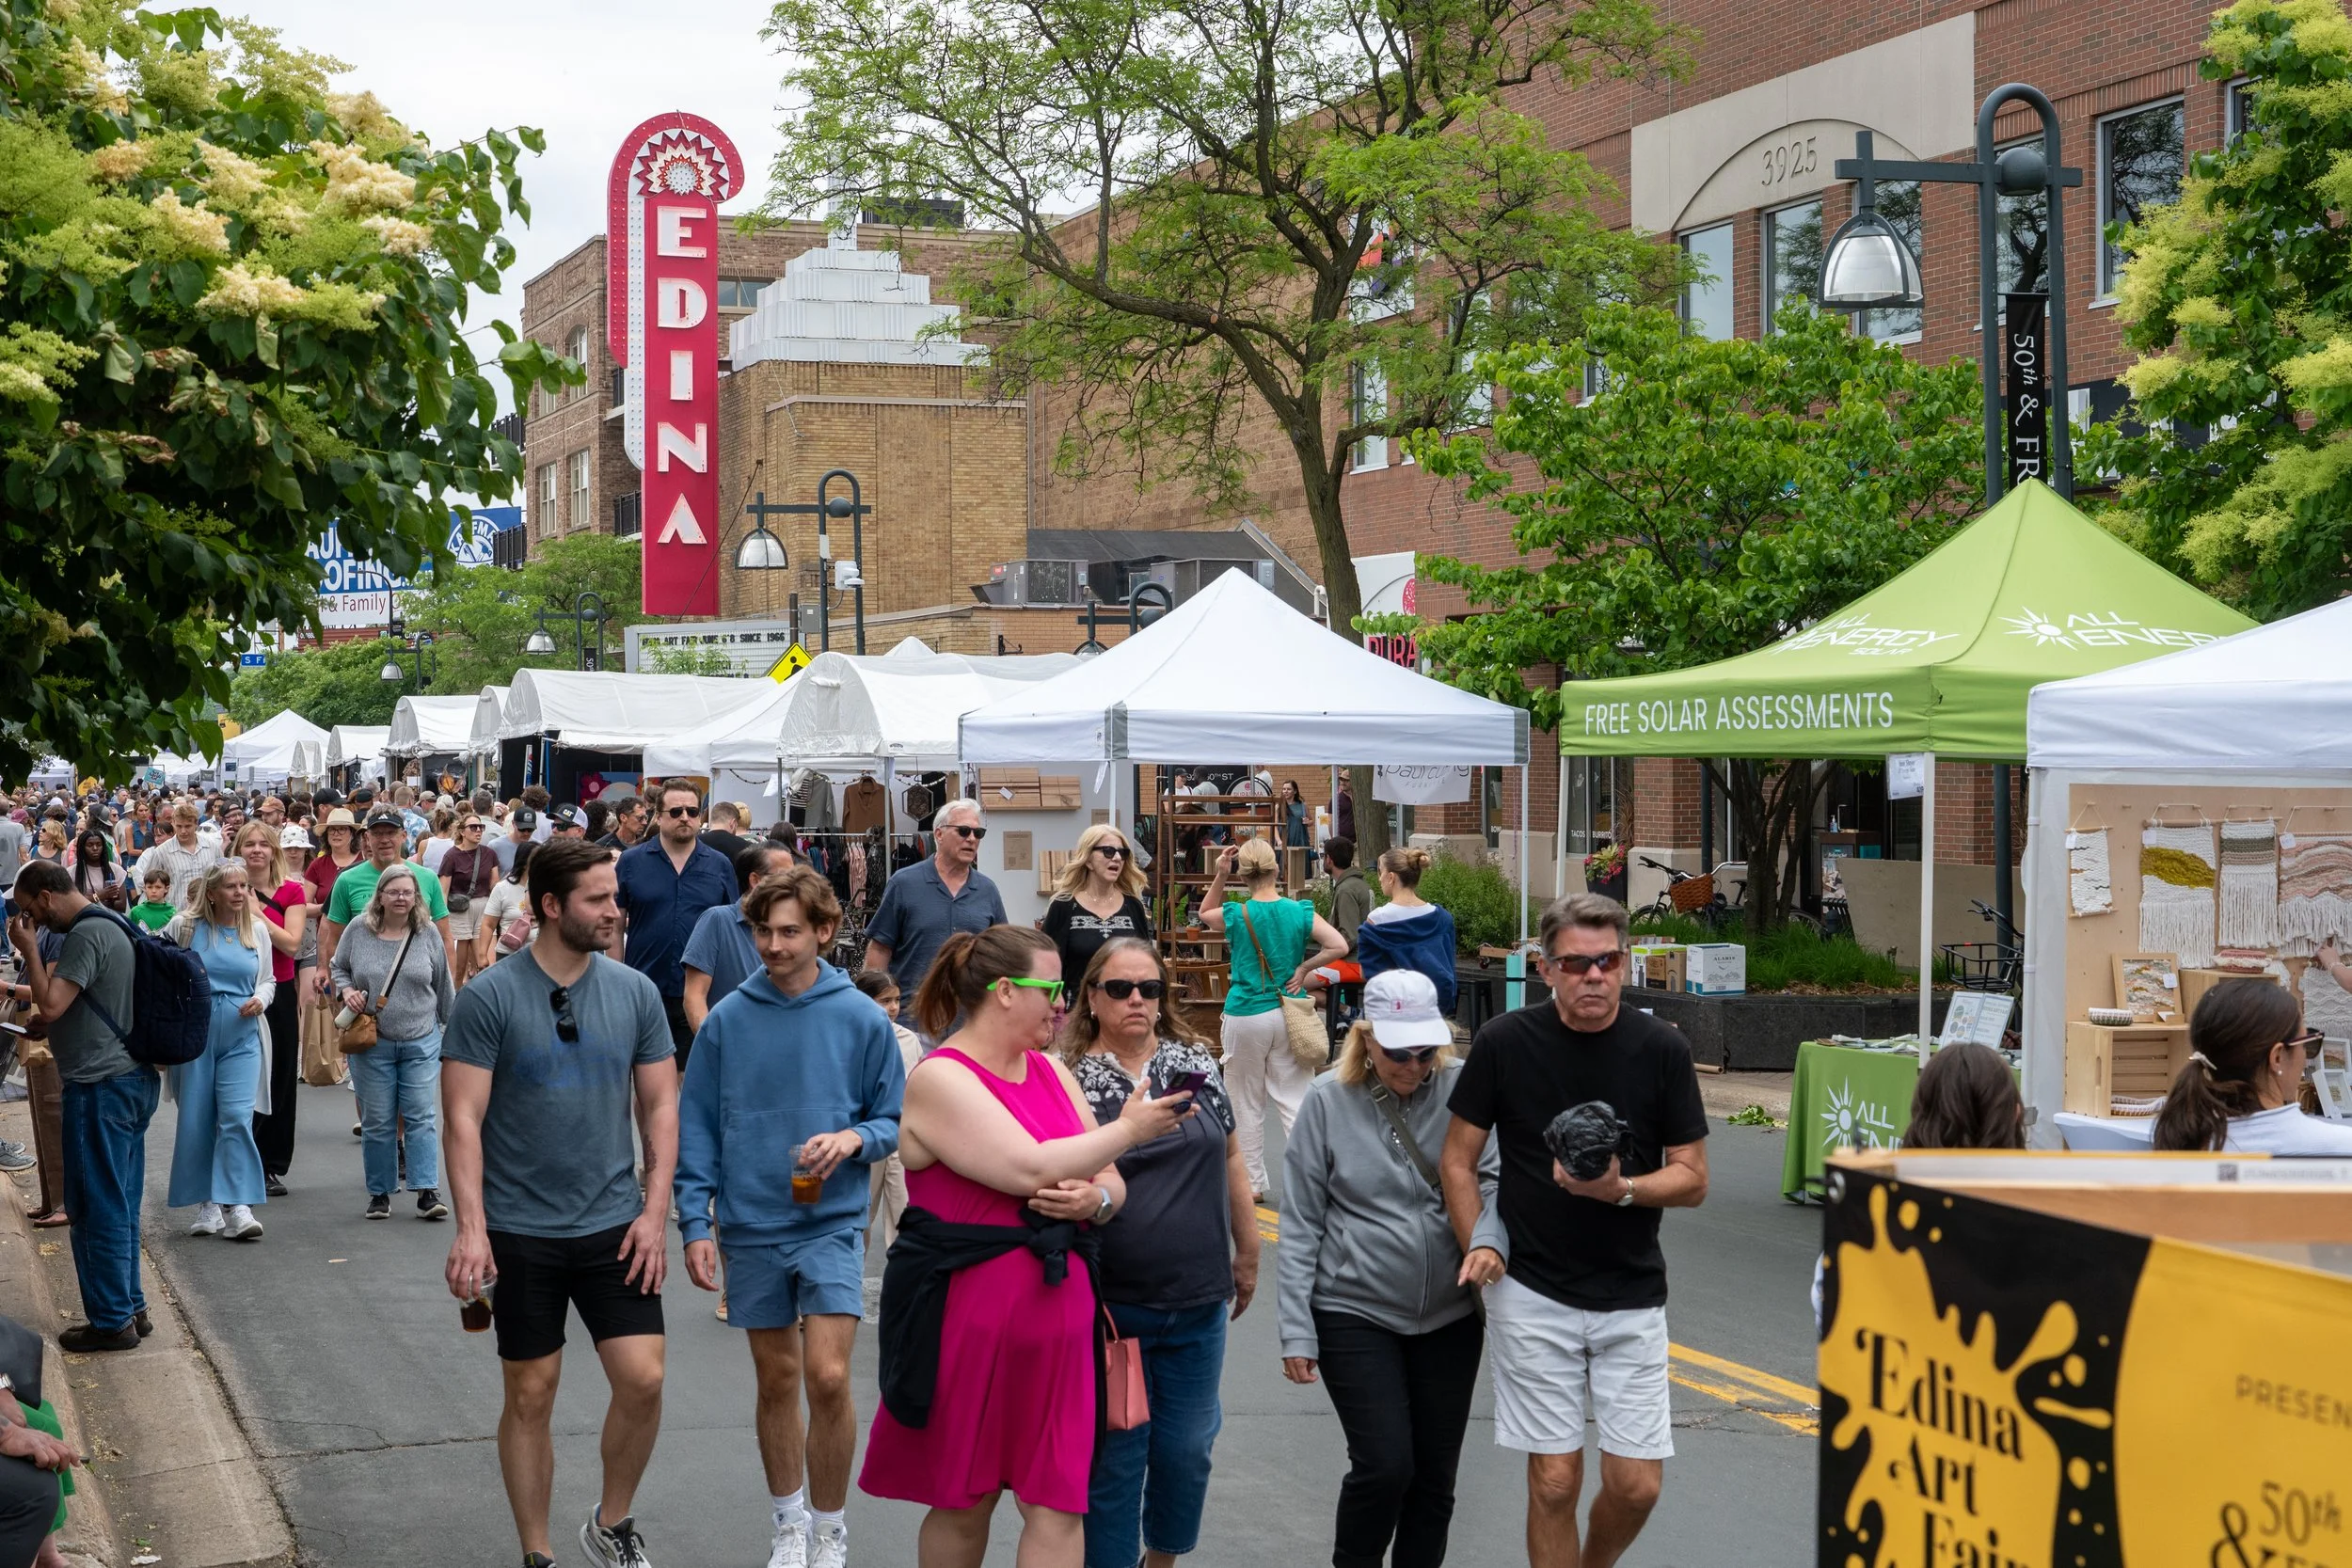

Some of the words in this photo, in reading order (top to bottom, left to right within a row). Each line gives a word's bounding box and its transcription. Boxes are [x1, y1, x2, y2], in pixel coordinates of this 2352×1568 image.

[1761, 136, 1818, 186] 3925
[2013, 333, 2038, 386] 50th
[657, 205, 707, 546] EDINA
[2015, 393, 2039, 427] &
[2015, 436, 2040, 487] FR
[342, 593, 387, 615] Family
[2066, 611, 2140, 628] ALL
[664, 637, 678, 646] ART
[739, 633, 762, 643] SINCE
[767, 632, 785, 642] 1966
[1791, 627, 1961, 650] ENERGY
[2072, 627, 2226, 647] ENER
[245, 656, 251, 664] S
[1585, 703, 1630, 736] FREE
[1638, 699, 1708, 733] SOLAR
[1715, 691, 1894, 730] ASSESSMENTS
[1221, 772, 1233, 781] ST
[563, 809, 574, 817] CAT
[1571, 830, 1585, 838] TACOS
[1855, 1101, 1895, 1129] ALL
[1854, 1326, 2024, 1462] Edina
[2235, 1372, 2352, 1430] PRESEN
[1888, 1435, 1979, 1517] Art
[2259, 1479, 2342, 1547] 50th
